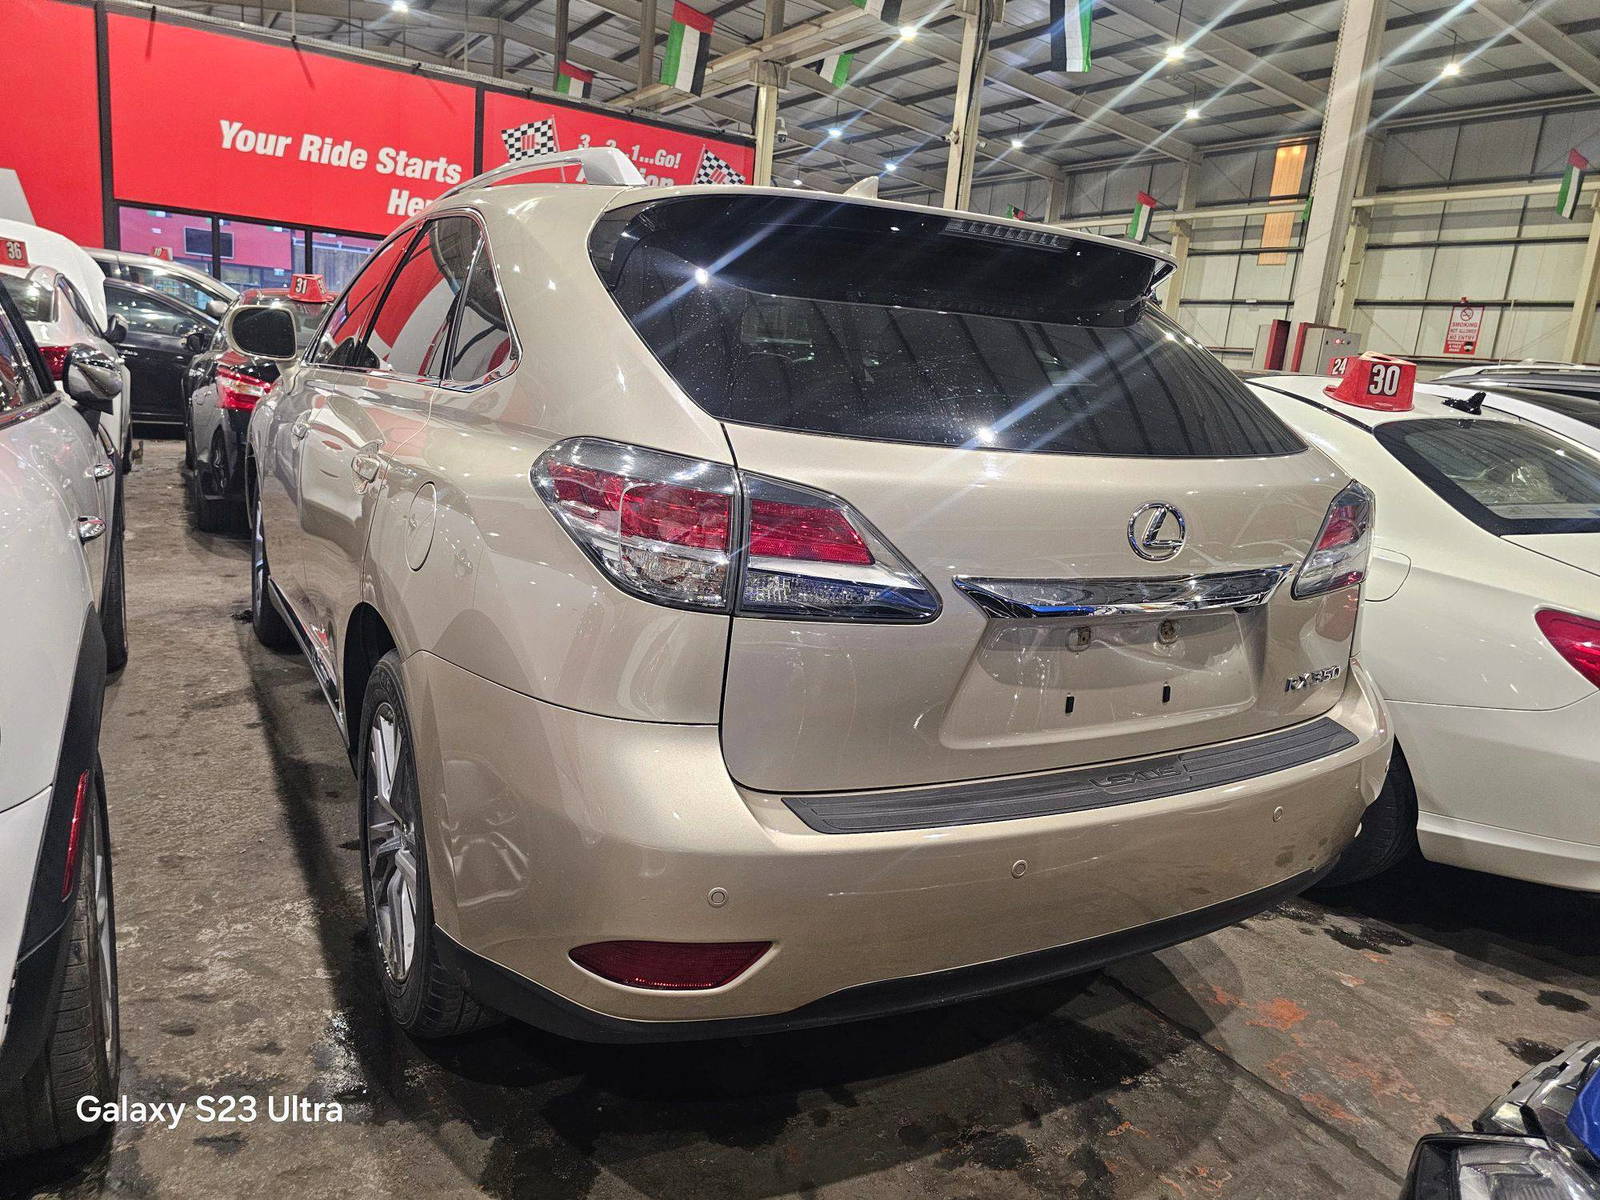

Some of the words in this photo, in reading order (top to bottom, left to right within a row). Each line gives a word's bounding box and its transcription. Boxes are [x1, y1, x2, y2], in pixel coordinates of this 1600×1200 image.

[219, 120, 292, 158] Your
[299, 133, 368, 170] Ride
[375, 147, 463, 185] Starts
[386, 188, 433, 217] He
[6, 241, 23, 260] 36
[295, 277, 308, 294] 31
[1332, 357, 1348, 375] 24
[1368, 364, 1400, 396] 30
[1311, 665, 1341, 685] 350
